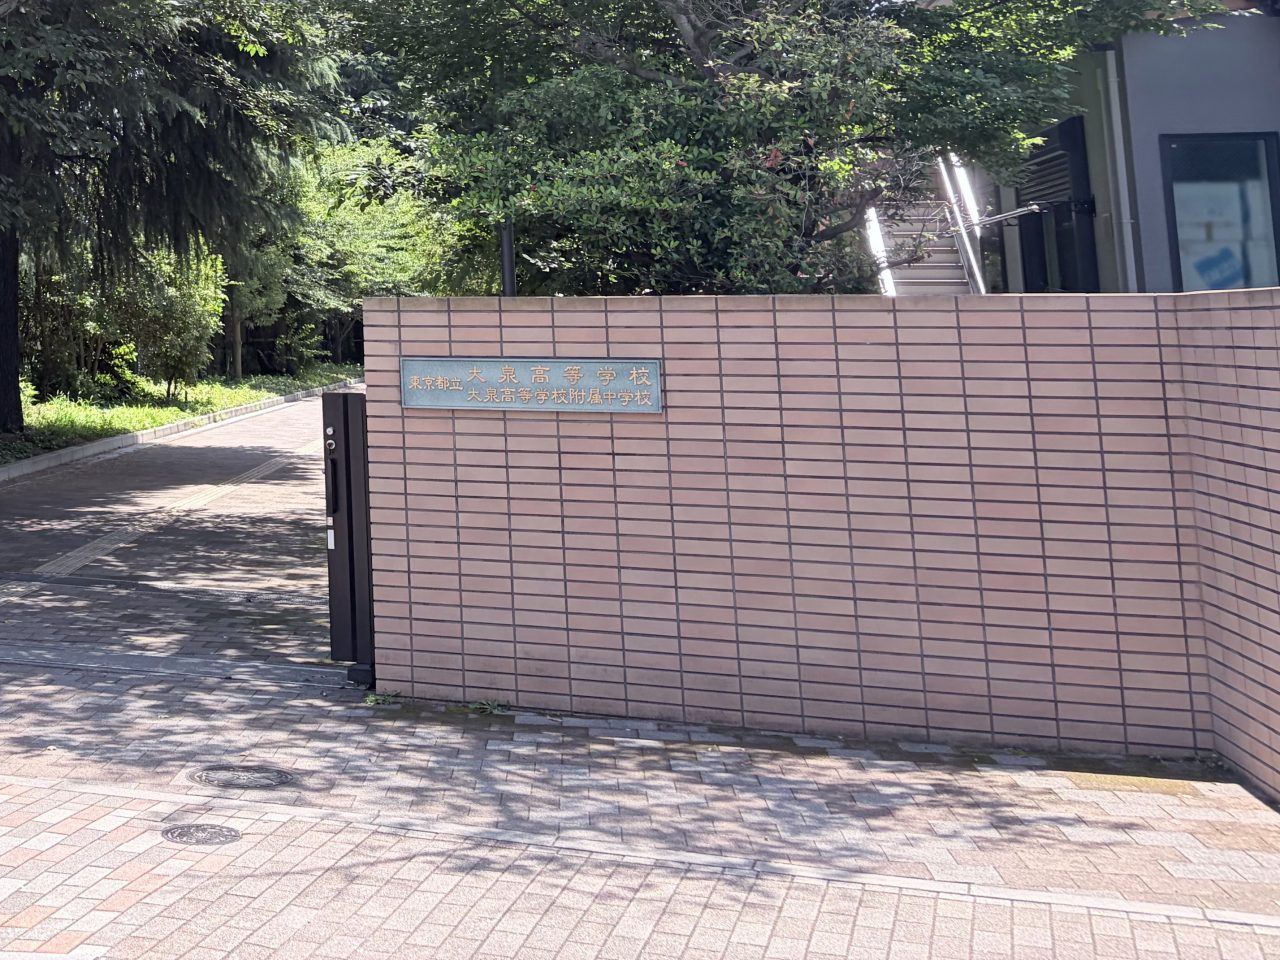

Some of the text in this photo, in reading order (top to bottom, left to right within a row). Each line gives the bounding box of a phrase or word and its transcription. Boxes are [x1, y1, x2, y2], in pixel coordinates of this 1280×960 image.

[409, 375, 463, 391] 東京都立
[466, 365, 653, 386] 大泉高等学校
[467, 387, 653, 406] 大泉高等学校附属中学校
